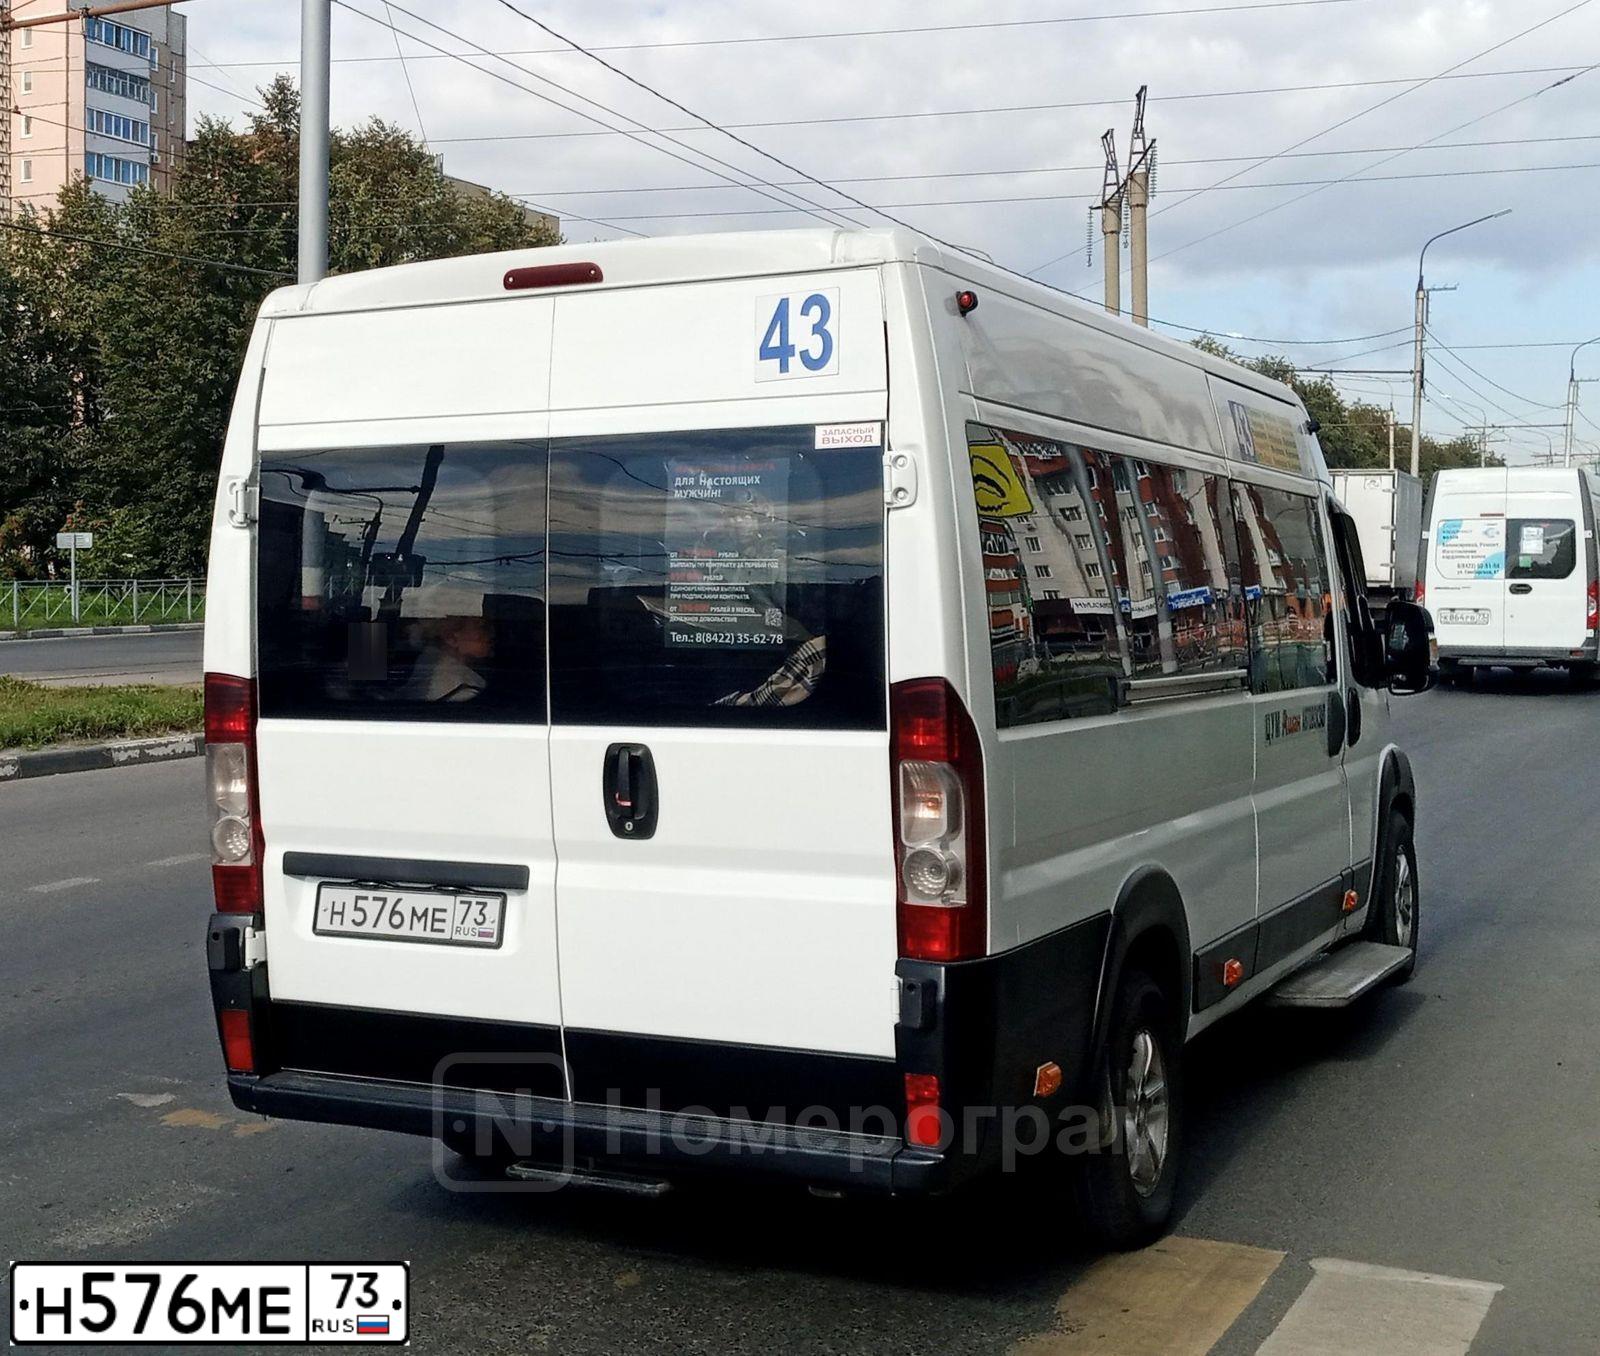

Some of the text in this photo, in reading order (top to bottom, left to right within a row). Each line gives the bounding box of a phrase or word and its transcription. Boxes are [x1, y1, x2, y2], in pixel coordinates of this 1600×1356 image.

[760, 293, 833, 374] 43
[822, 427, 874, 436] ЗАПАСНЫЙ
[822, 435, 873, 444] ВЫХОД
[674, 475, 761, 488] ДЛЯ НАСТОЯЩИХ
[674, 489, 721, 498] МУЖЧИН!
[670, 632, 784, 645] Тел.: 8(8422) 35-62-78
[329, 895, 488, 933] Н576МЕ 73
[454, 926, 477, 937] RUS
